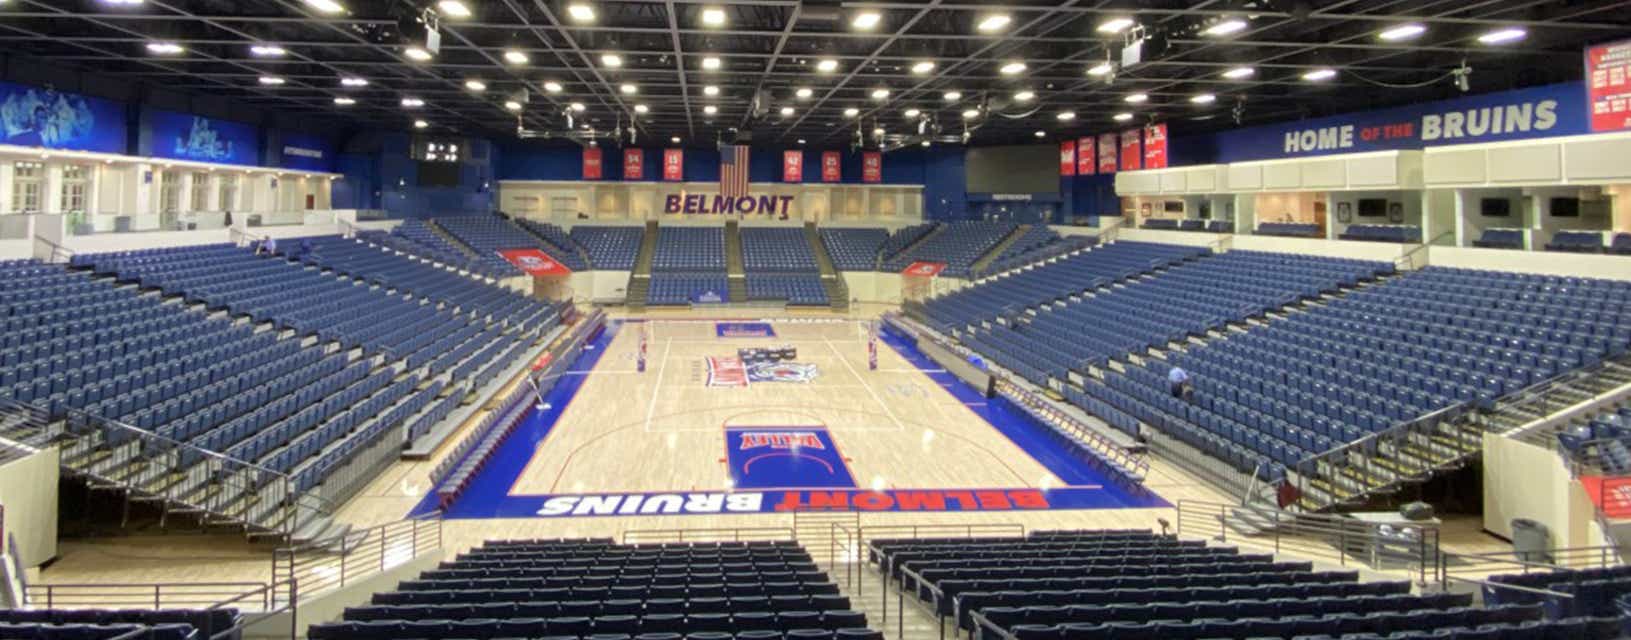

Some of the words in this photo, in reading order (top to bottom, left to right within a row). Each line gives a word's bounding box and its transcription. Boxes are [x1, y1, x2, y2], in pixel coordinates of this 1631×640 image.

[1284, 125, 1354, 152] HOME
[1360, 128, 1380, 141] OF
[1383, 123, 1413, 138] THE
[1421, 100, 1558, 140] BRUINS
[664, 194, 794, 214] BELMONT
[536, 493, 763, 516] BRUINS
[775, 489, 1049, 512] BELMONT
